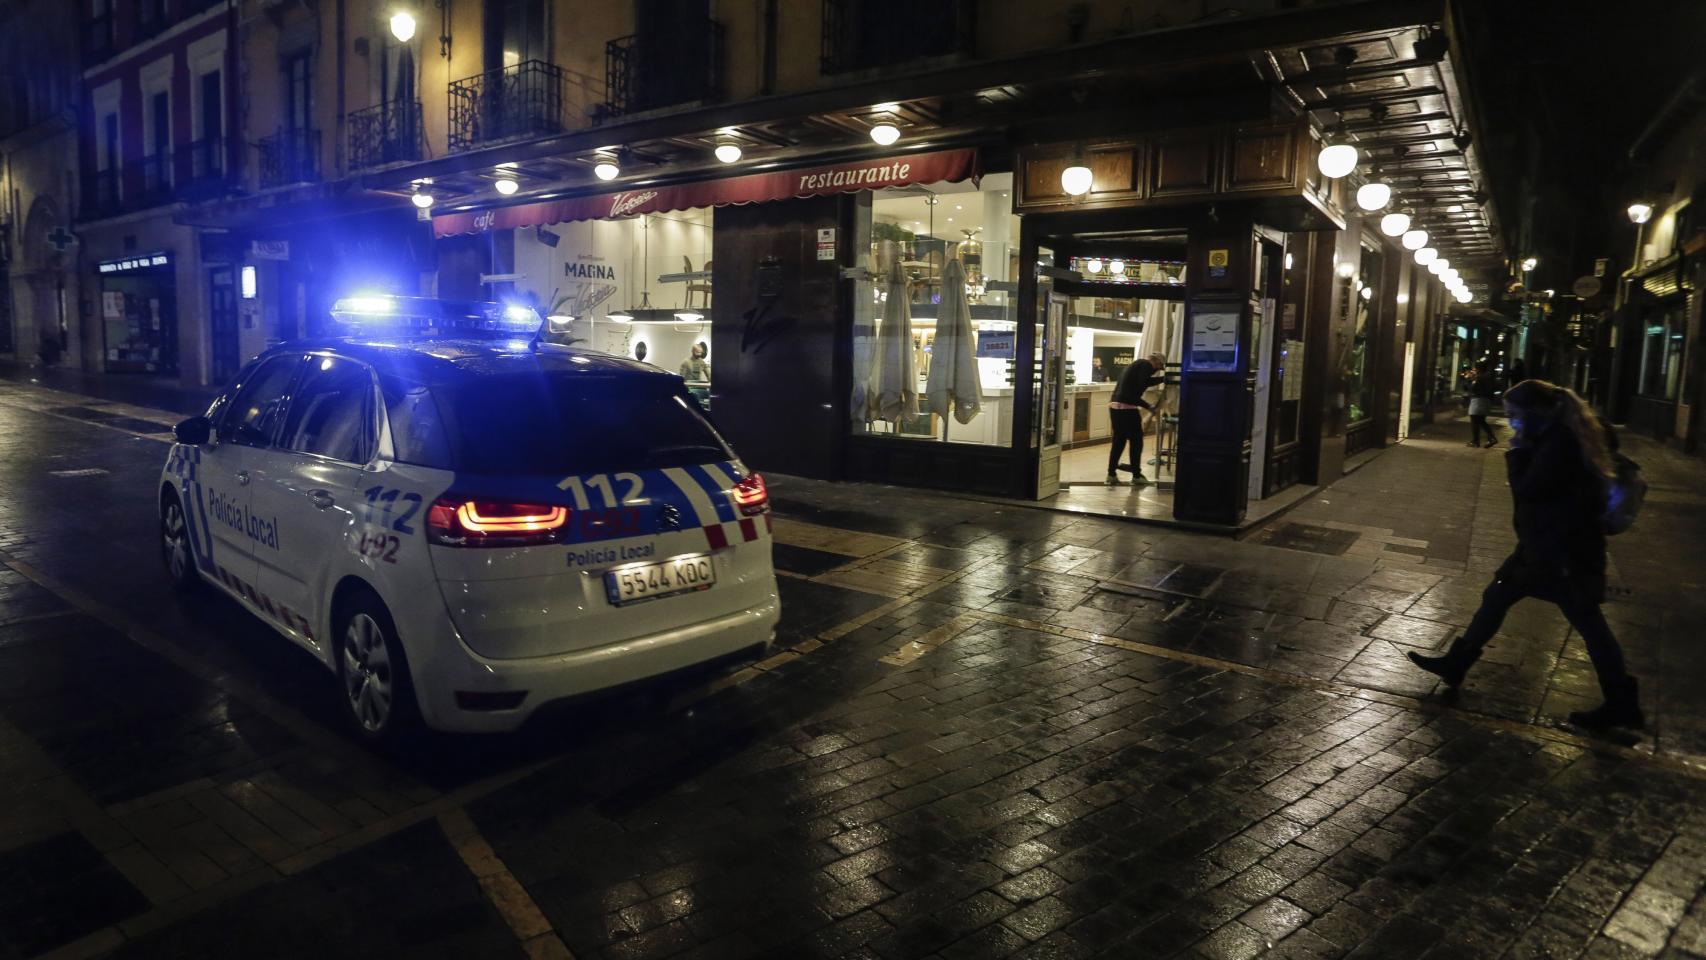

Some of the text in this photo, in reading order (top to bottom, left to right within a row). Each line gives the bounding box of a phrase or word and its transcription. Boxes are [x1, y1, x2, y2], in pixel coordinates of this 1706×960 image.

[799, 162, 911, 190] restaurante
[473, 210, 496, 231] café
[564, 262, 615, 280] MAGNA
[556, 472, 652, 510] 112
[208, 487, 279, 551] Policía Local
[364, 485, 422, 536] 112
[620, 541, 655, 560] Local
[621, 566, 670, 595] 5544
